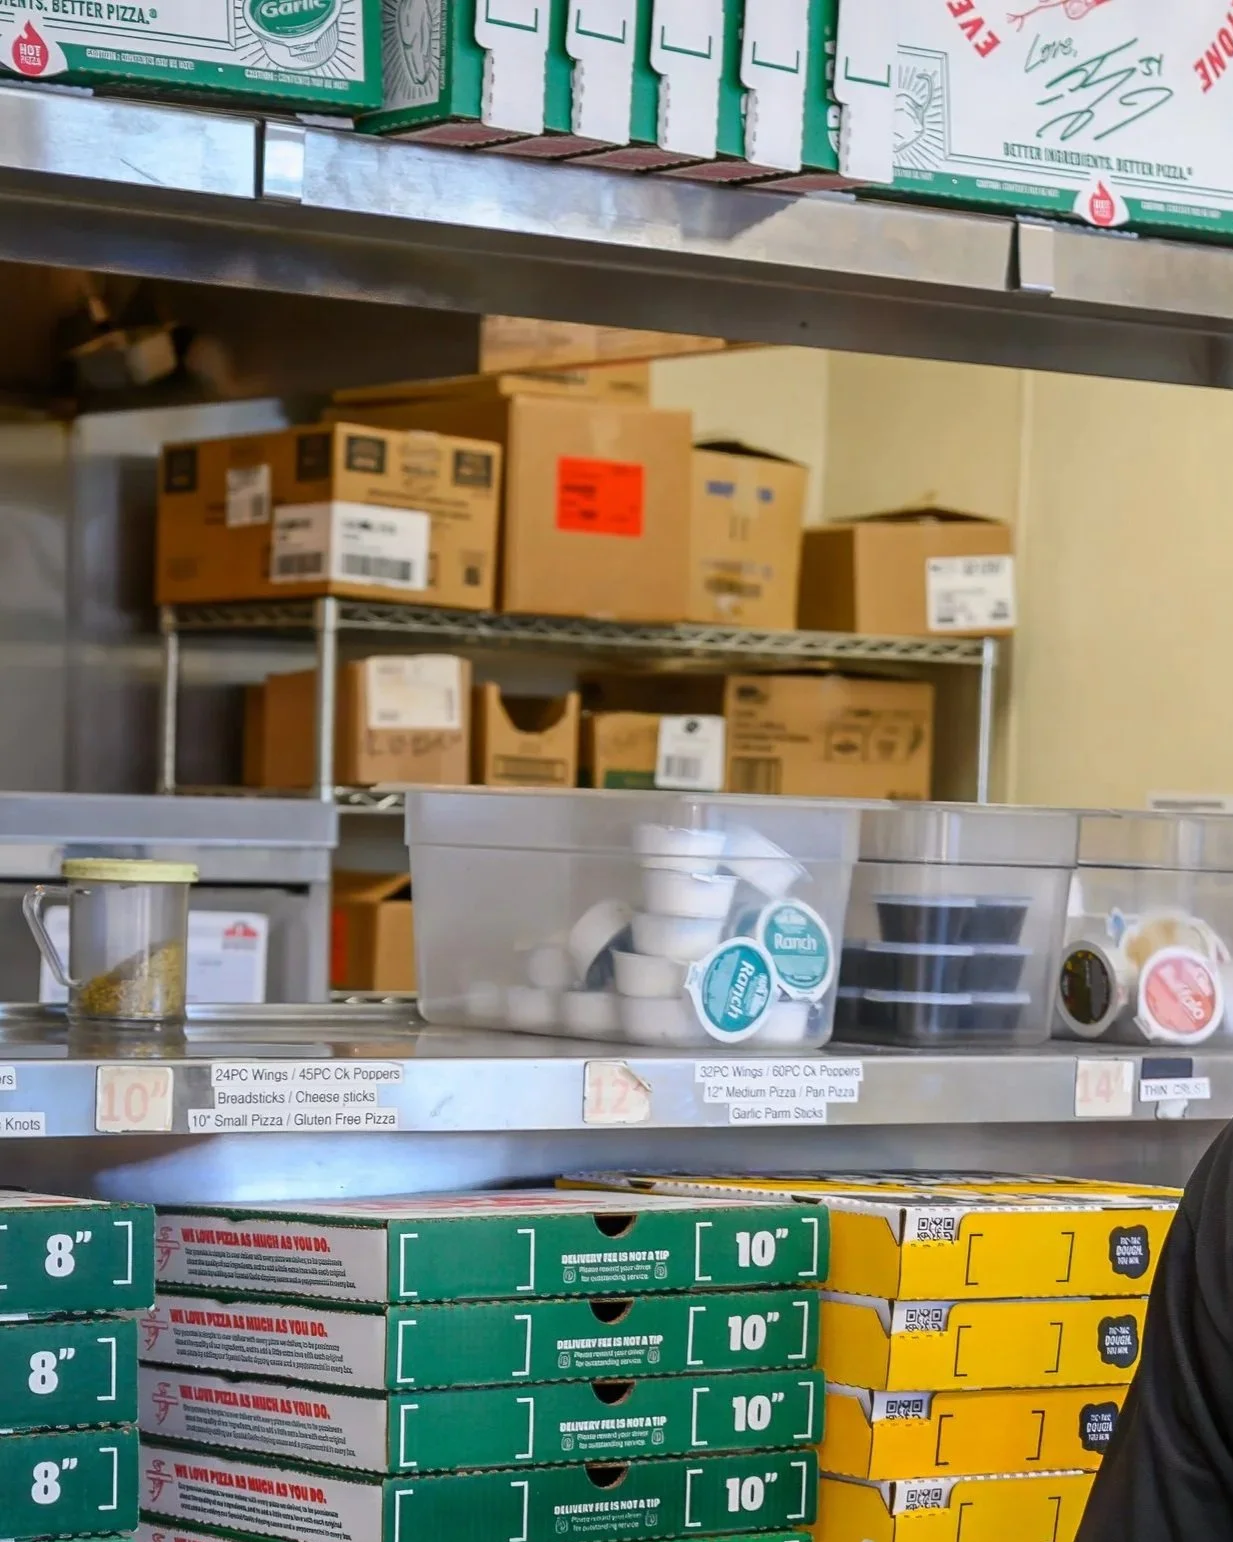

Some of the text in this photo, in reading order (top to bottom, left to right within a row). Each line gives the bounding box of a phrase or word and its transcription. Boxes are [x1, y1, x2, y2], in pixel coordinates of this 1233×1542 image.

[52, 0, 103, 19] BETTER
[19, 43, 41, 57] HOT
[1003, 142, 1042, 160] BETTER
[1116, 158, 1153, 175] BETTER
[774, 933, 818, 952] Ranch
[727, 960, 756, 1019] Ranch
[215, 1068, 248, 1081] 24PC
[252, 1068, 288, 1082] Wings
[298, 1067, 331, 1080] 45PC
[334, 1067, 351, 1080] Ck
[353, 1067, 400, 1081] Poppers
[700, 1066, 729, 1078] 32PC
[732, 1066, 763, 1079] Wings
[772, 1065, 800, 1077] 60PC
[218, 1091, 285, 1104] Breadsticks
[295, 1090, 340, 1103] Cheese
[343, 1090, 376, 1103] sticks
[726, 1086, 765, 1098] Medium
[769, 1086, 796, 1098] Pizza
[805, 1086, 825, 1098] Pan
[828, 1086, 854, 1097] Pizza
[1144, 1085, 1168, 1096] THIN
[214, 1114, 248, 1127] Small
[251, 1113, 283, 1126] Pizza
[294, 1113, 332, 1126] Gluten
[335, 1112, 361, 1125] Free
[365, 1112, 396, 1125] Pizza
[732, 1107, 823, 1119] Garlic Parm Sticks
[6, 1117, 41, 1131] Knots
[181, 1228, 331, 1253] WE LOVE PIZZA AS MUCH AS YOU DO.
[736, 1228, 788, 1267] 10"
[45, 1231, 92, 1278] 8"
[728, 1312, 780, 1351] 10"
[28, 1347, 76, 1394] 8"
[732, 1392, 785, 1432] 10"
[31, 1458, 78, 1504] 8"
[725, 1472, 778, 1512] 10"
